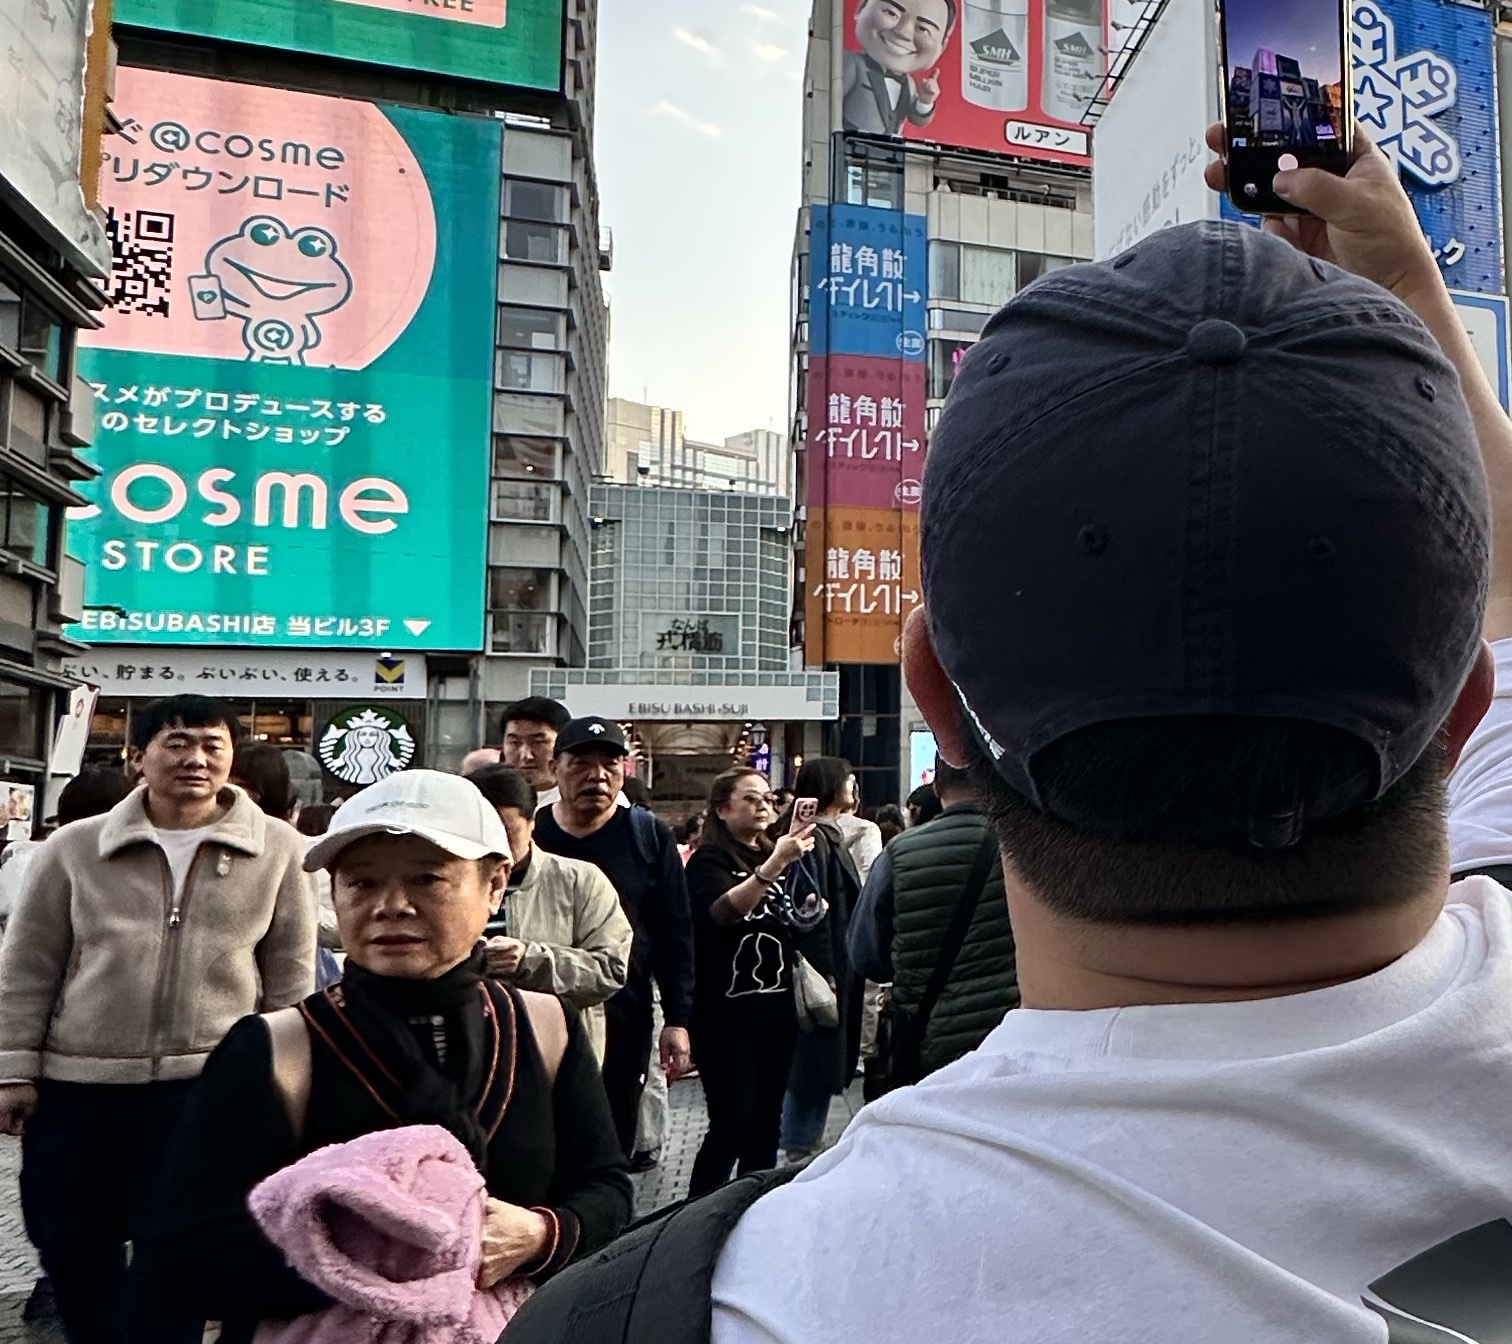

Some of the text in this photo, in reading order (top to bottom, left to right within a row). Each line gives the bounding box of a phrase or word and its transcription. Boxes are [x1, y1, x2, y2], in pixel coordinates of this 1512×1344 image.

[100, 153, 351, 207] リダウンロード
[831, 242, 908, 280] 龍角散
[829, 393, 906, 428] 龍角散
[102, 413, 351, 446] のセレクトショップ
[66, 463, 409, 534] osme
[102, 541, 270, 576] STORE
[827, 547, 905, 581] 龍角散
[288, 616, 391, 637] 当ビル3F
[373, 685, 405, 693] POINT
